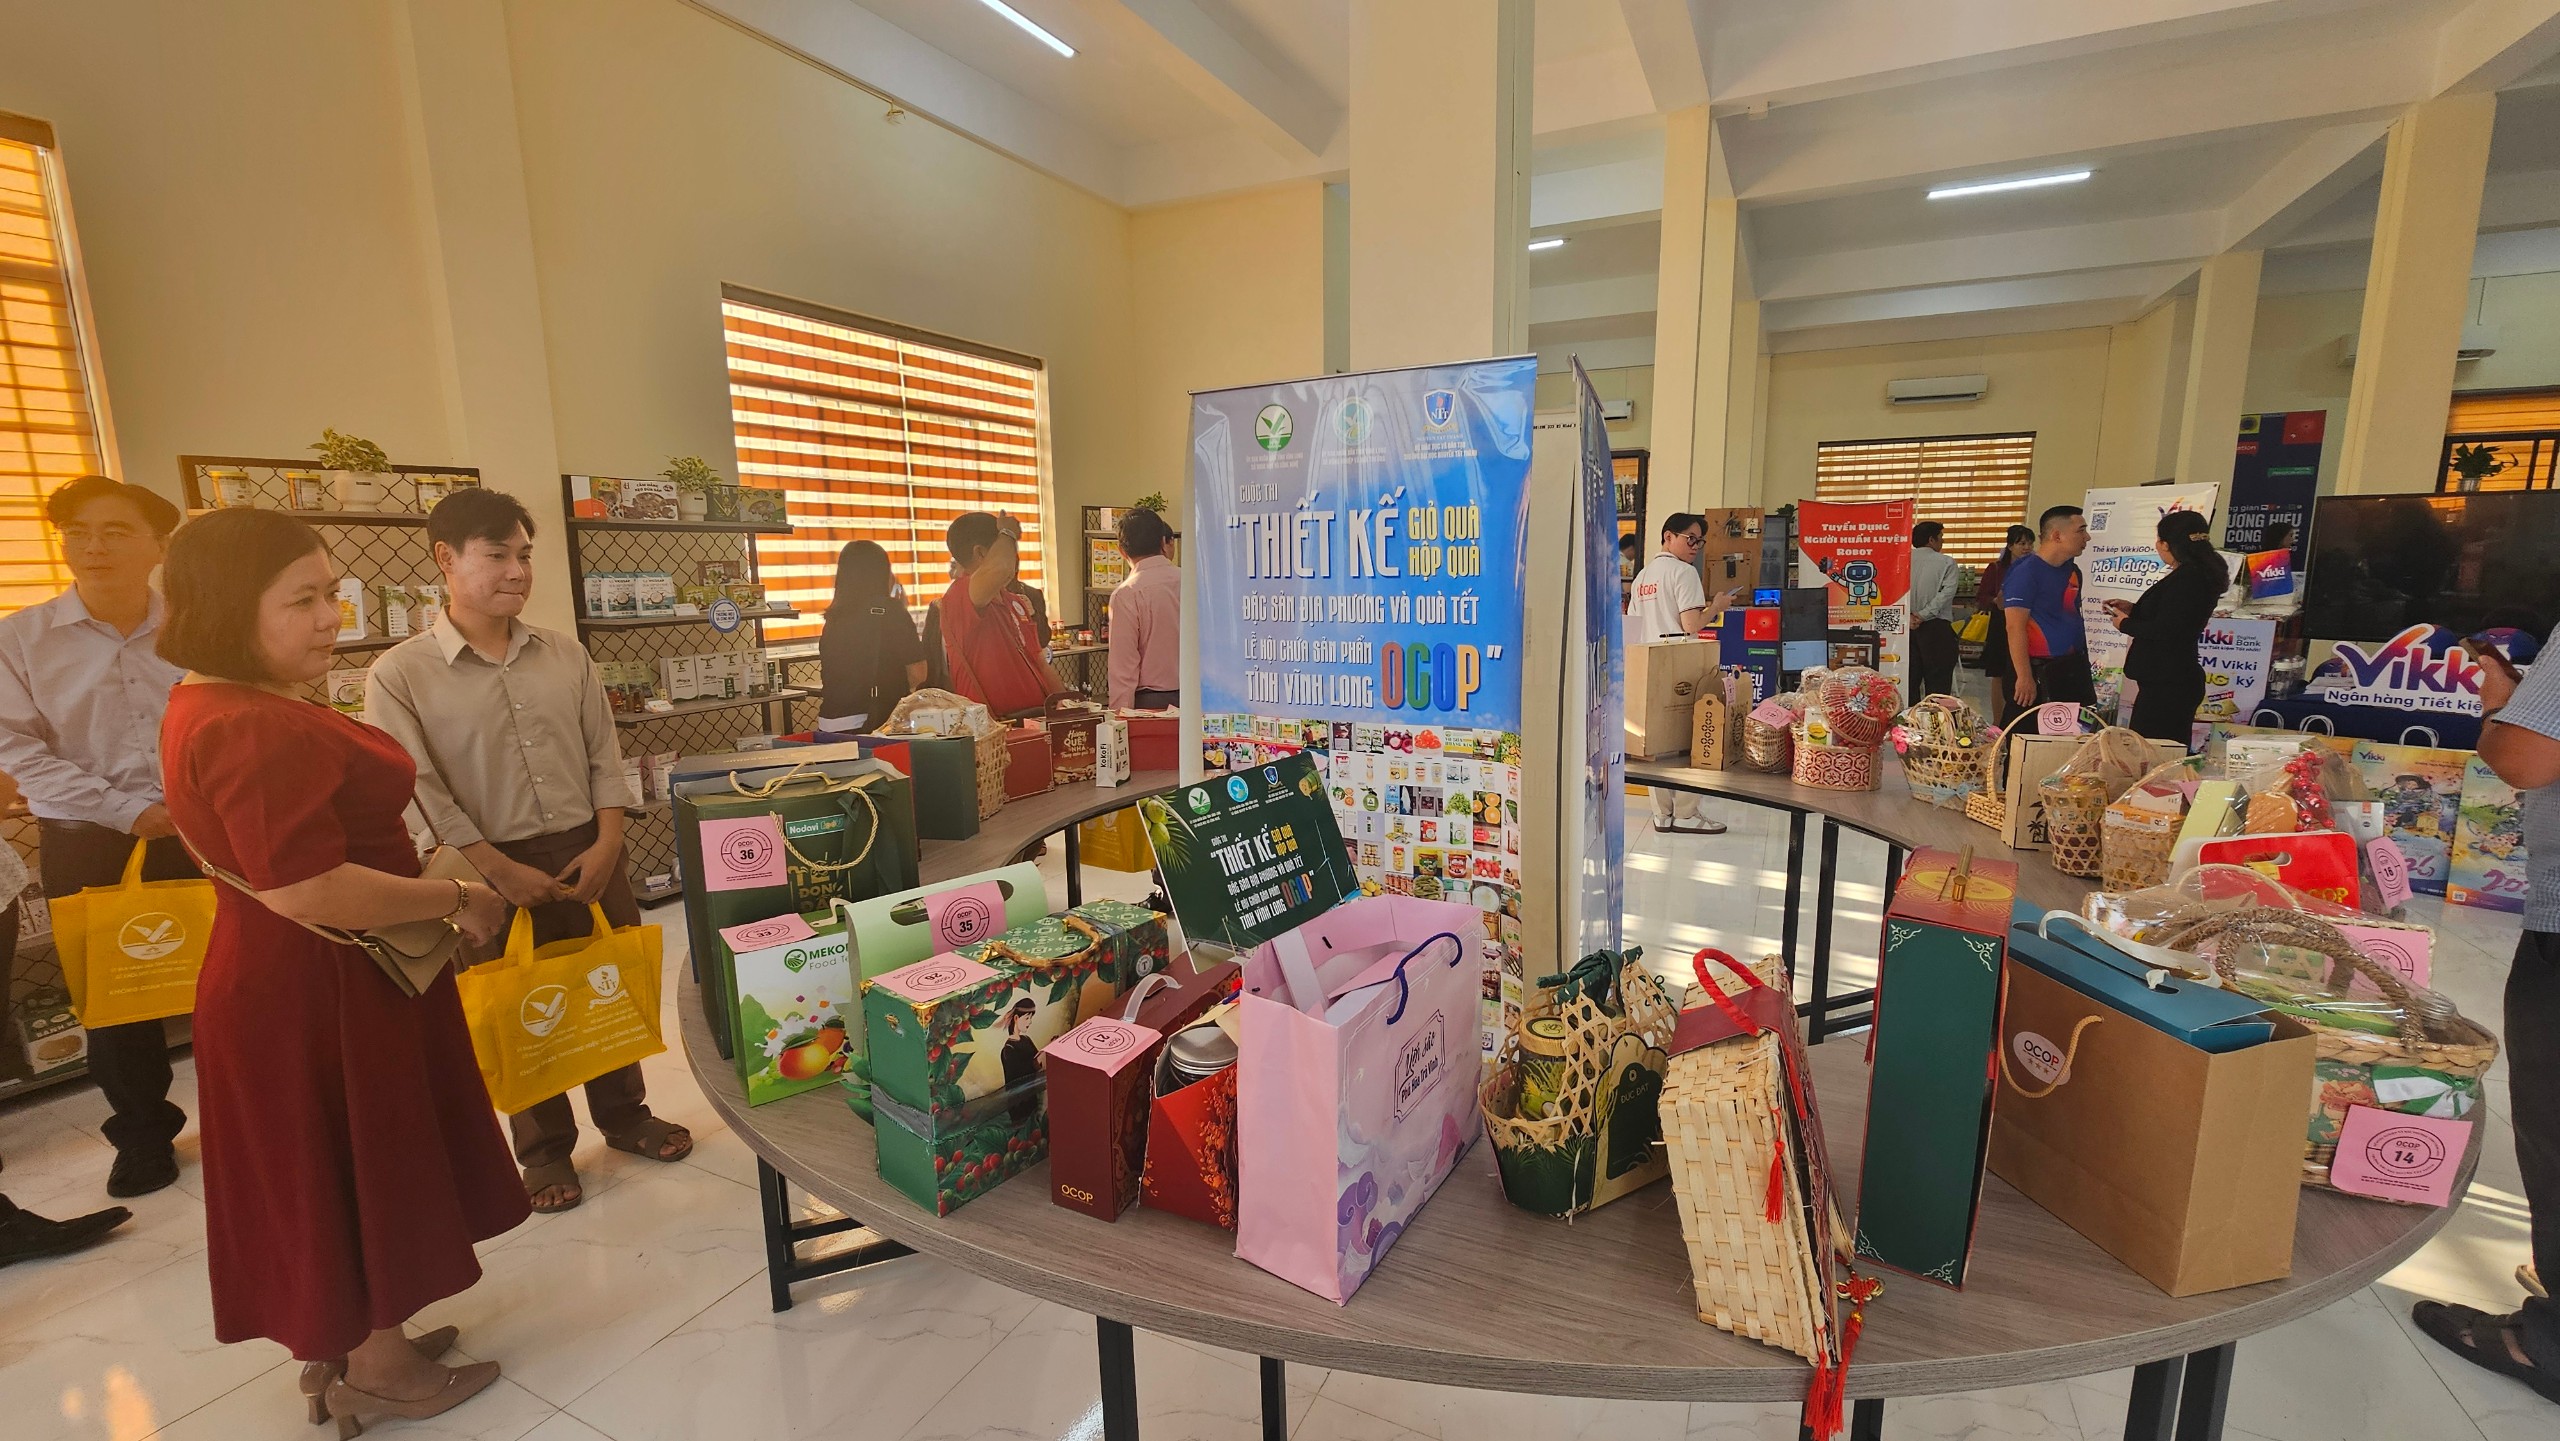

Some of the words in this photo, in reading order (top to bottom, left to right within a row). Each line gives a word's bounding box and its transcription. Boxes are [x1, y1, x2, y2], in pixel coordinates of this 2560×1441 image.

[1240, 483, 1262, 505] CUỘC
[1265, 483, 1279, 502] THI
[1408, 500, 1438, 541] GIỎ
[1444, 499, 1480, 542] QUÀ
[1349, 485, 1405, 579] KẾ
[1409, 540, 1442, 582] HỘP
[1447, 540, 1480, 579] QUÀ
[2123, 559, 2159, 576] được
[2257, 565, 2285, 578] Vikki
[2107, 575, 2117, 583] ai
[2120, 575, 2143, 587] cũng
[1242, 590, 1267, 625] ĐẶC
[1271, 590, 1295, 622] SẢN
[1300, 595, 1324, 627] ĐỊA
[1328, 594, 1385, 623] PHƯƠNG
[1390, 591, 1411, 624] VÀ
[1416, 590, 1446, 626] QUÀ
[1451, 588, 1479, 625] TẾT
[1245, 632, 1258, 660] LỄ
[1261, 635, 1277, 664] HỘI
[1280, 636, 1309, 662] CHỨA
[1313, 636, 1337, 663] SẢN
[1340, 635, 1373, 665] PHẨM
[2222, 660, 2257, 670] Vikki
[2336, 626, 2481, 694] Vikk
[1245, 665, 1279, 703] TỈNH
[1284, 669, 1324, 706] VĨNH
[1330, 674, 1374, 709] LONG
[2236, 675, 2254, 688] ký
[2328, 690, 2369, 706] Ngân
[2374, 693, 2414, 708] hàng
[2419, 696, 2452, 708] Tiết
[2457, 699, 2483, 713] kiệ
[2359, 751, 2386, 762] Vikki
[789, 822, 819, 835] Nodavi
[1253, 824, 1276, 863] KẾ
[740, 849, 755, 860] 36
[2384, 868, 2393, 877] 16
[957, 911, 972, 919] OCOP
[960, 920, 973, 933] 35
[810, 958, 836, 971] Food
[1094, 1033, 1110, 1043] 21
[2024, 1040, 2059, 1066] OCOP
[2396, 1140, 2420, 1149] OCOP
[2394, 1151, 2414, 1164] 14
[1061, 1184, 1094, 1202] OCOP
